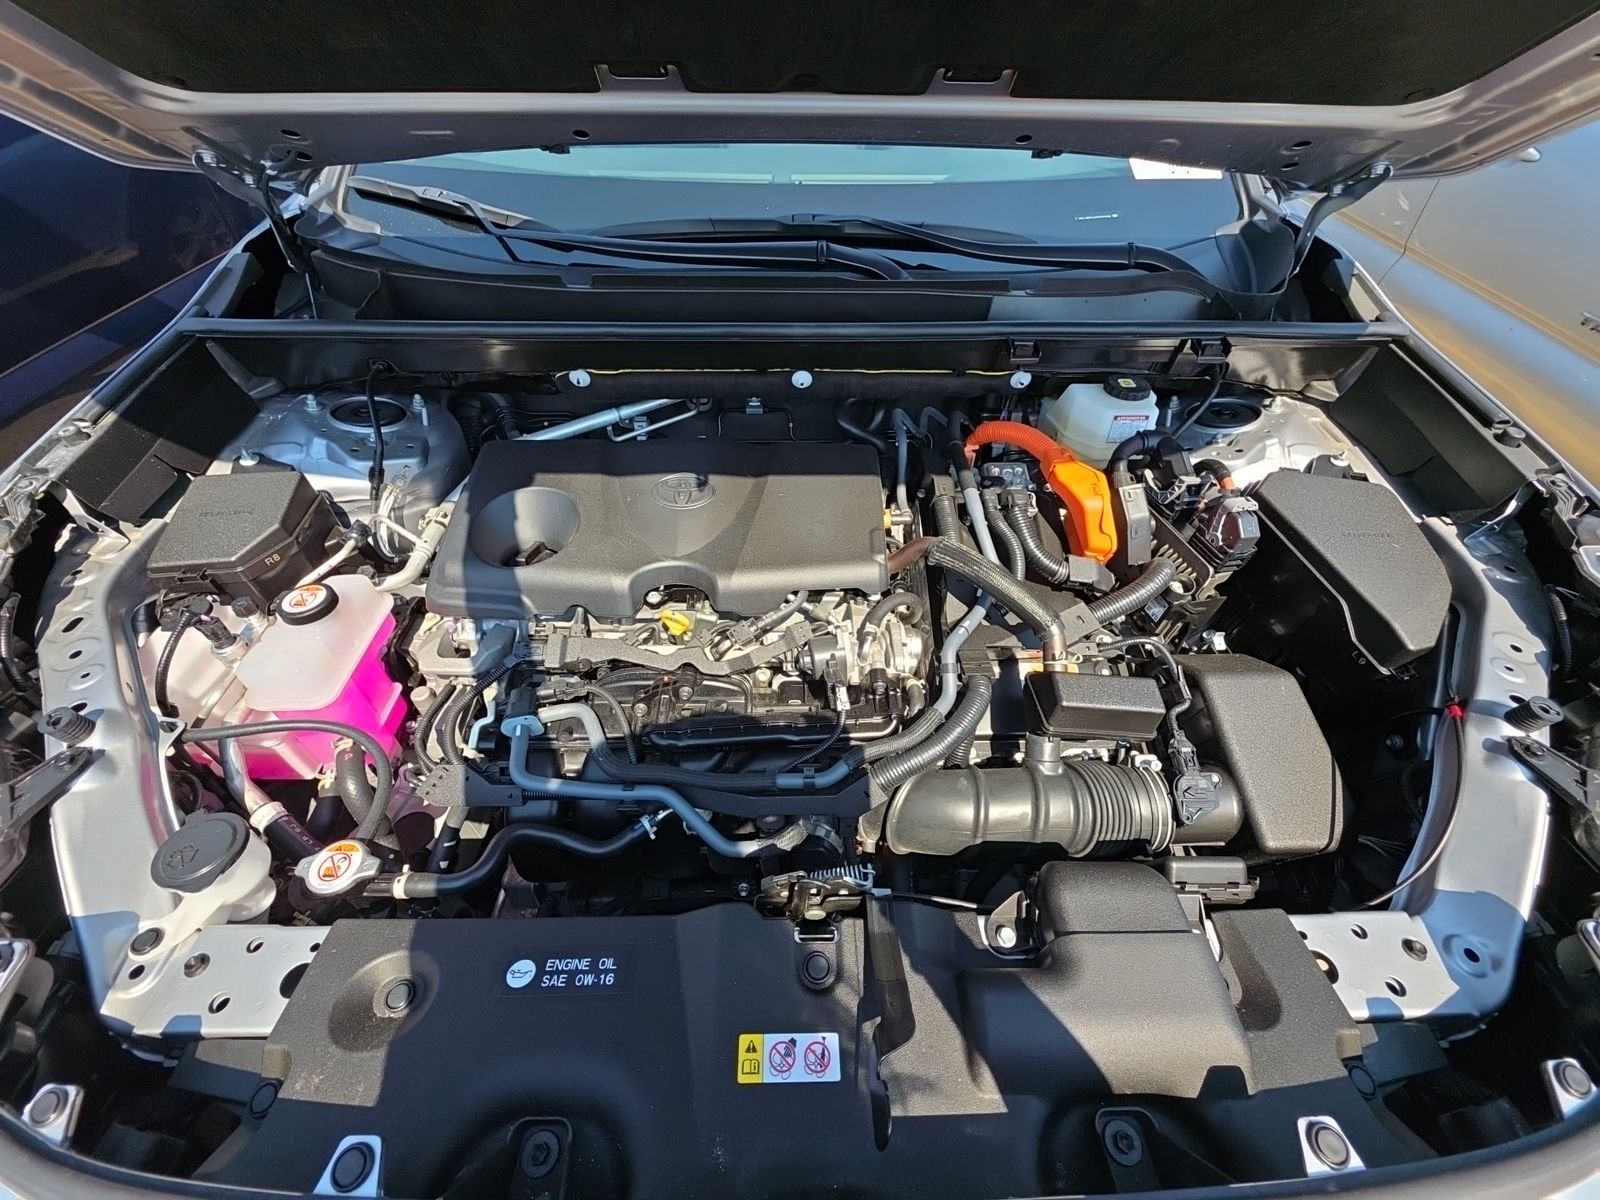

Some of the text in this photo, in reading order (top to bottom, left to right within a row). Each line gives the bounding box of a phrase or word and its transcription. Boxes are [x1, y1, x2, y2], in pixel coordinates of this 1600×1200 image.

[264, 553, 281, 566] R8
[1351, 650, 1366, 665] L9
[545, 957, 618, 971] ENGINE OIL
[541, 973, 615, 987] SAE 0W-16
